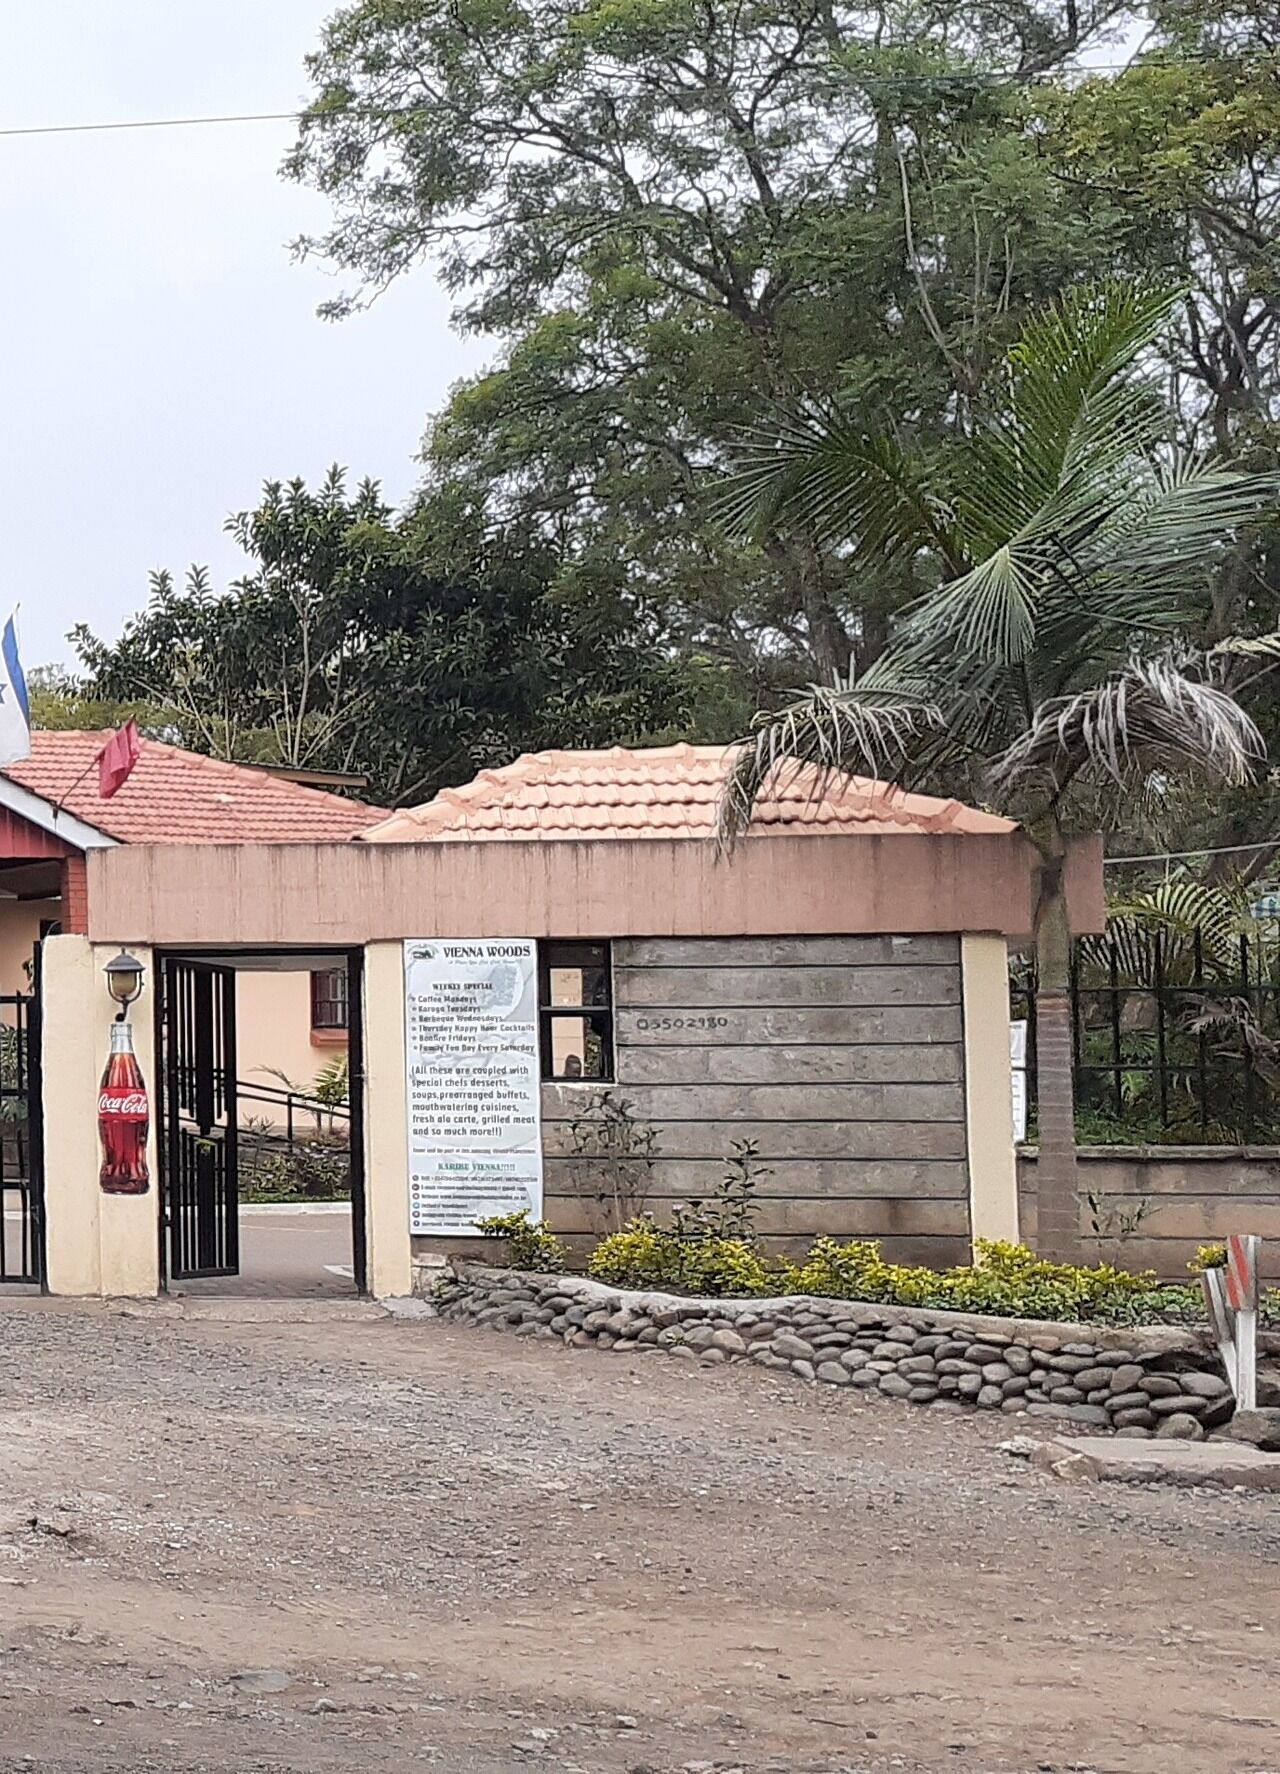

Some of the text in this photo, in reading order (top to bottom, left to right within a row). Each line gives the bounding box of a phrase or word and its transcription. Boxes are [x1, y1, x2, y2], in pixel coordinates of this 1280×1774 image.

[443, 946, 484, 958] VIENNA
[487, 945, 531, 957] WOODS
[418, 995, 477, 1004] Coffee Mondays
[447, 1005, 481, 1013] Tuesdays
[456, 1015, 502, 1023] Wednesdays
[419, 1025, 453, 1033] Thursday
[455, 1025, 478, 1033] Happy
[500, 1024, 535, 1032] Cocktails
[419, 1034, 476, 1042] Bonfire Fridays
[419, 1044, 444, 1053] Family
[462, 1044, 476, 1053] Day
[478, 1044, 498, 1053] Every
[500, 1044, 535, 1053] Saturday
[412, 1066, 529, 1077] (All these are coupled with
[412, 1078, 510, 1088] special chefs desserts,
[496, 1090, 530, 1100] buffets,
[412, 1102, 520, 1113] mouthwatering cuisines,
[412, 1114, 536, 1125] fresh ala carte, grilled meat
[412, 1126, 502, 1137] and so much more!!)
